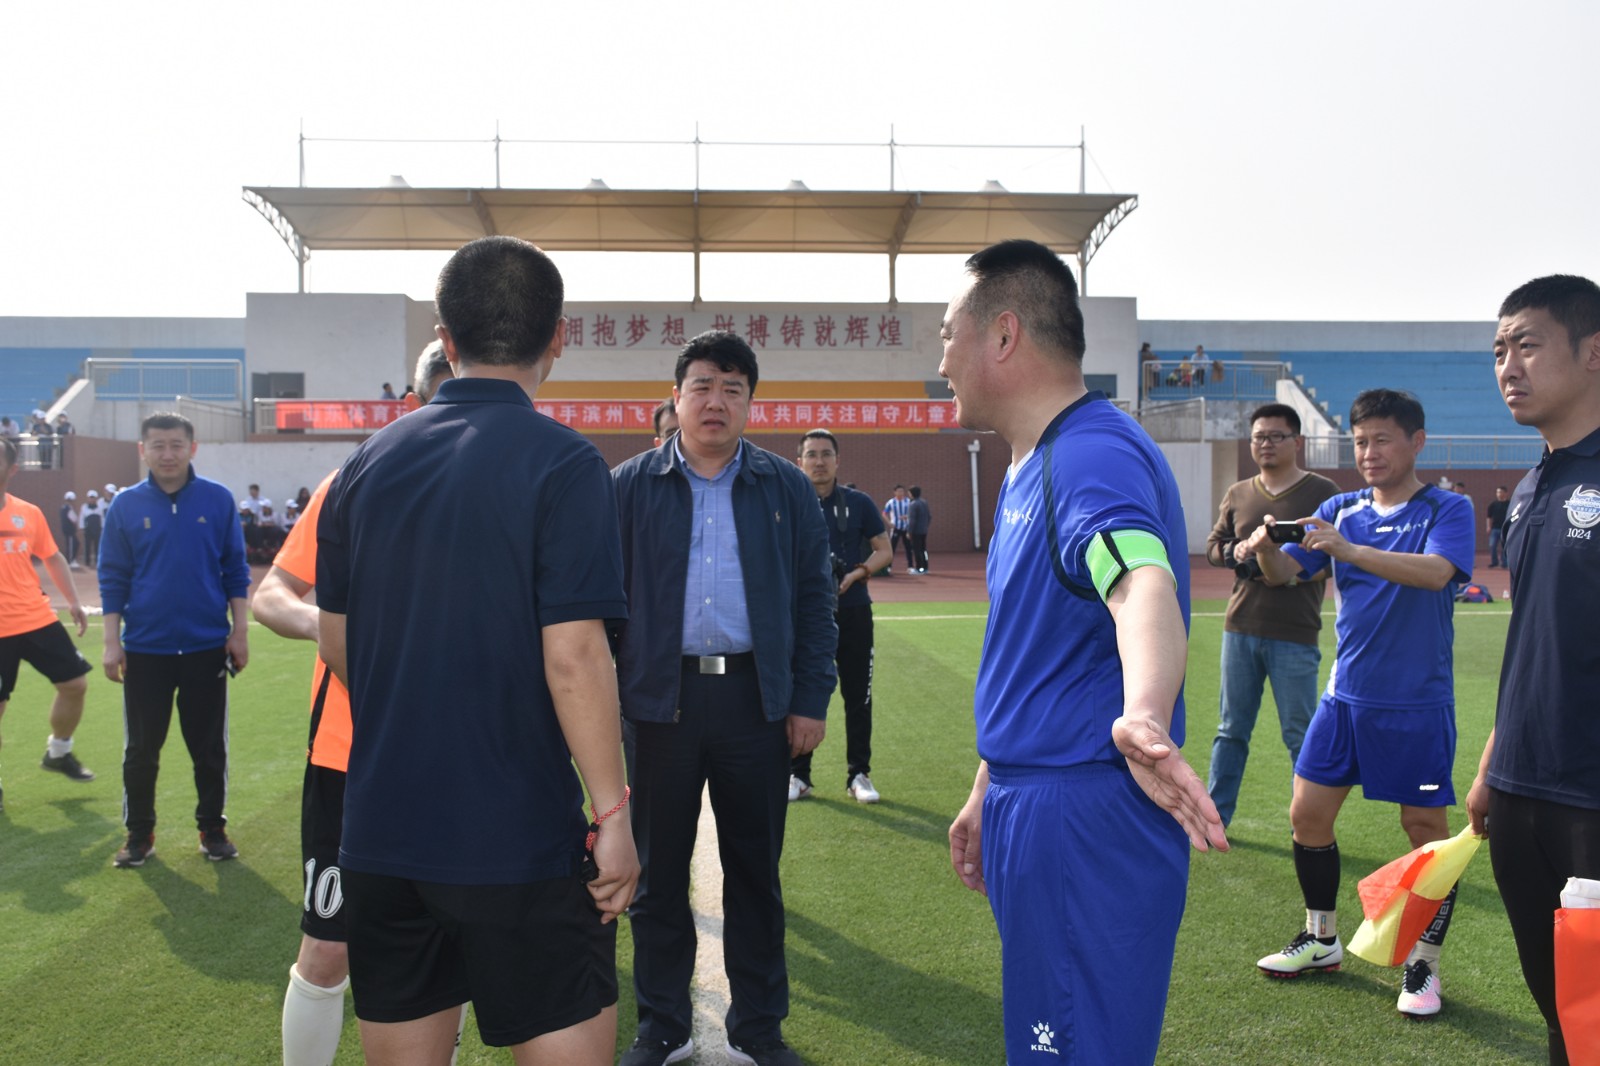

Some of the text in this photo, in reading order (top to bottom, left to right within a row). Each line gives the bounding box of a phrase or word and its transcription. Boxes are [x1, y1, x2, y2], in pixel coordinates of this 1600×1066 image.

[564, 313, 687, 347] 拥抱梦想
[537, 405, 656, 424] 手滨州飞
[1566, 527, 1592, 540] 1024
[304, 858, 344, 918] 10
